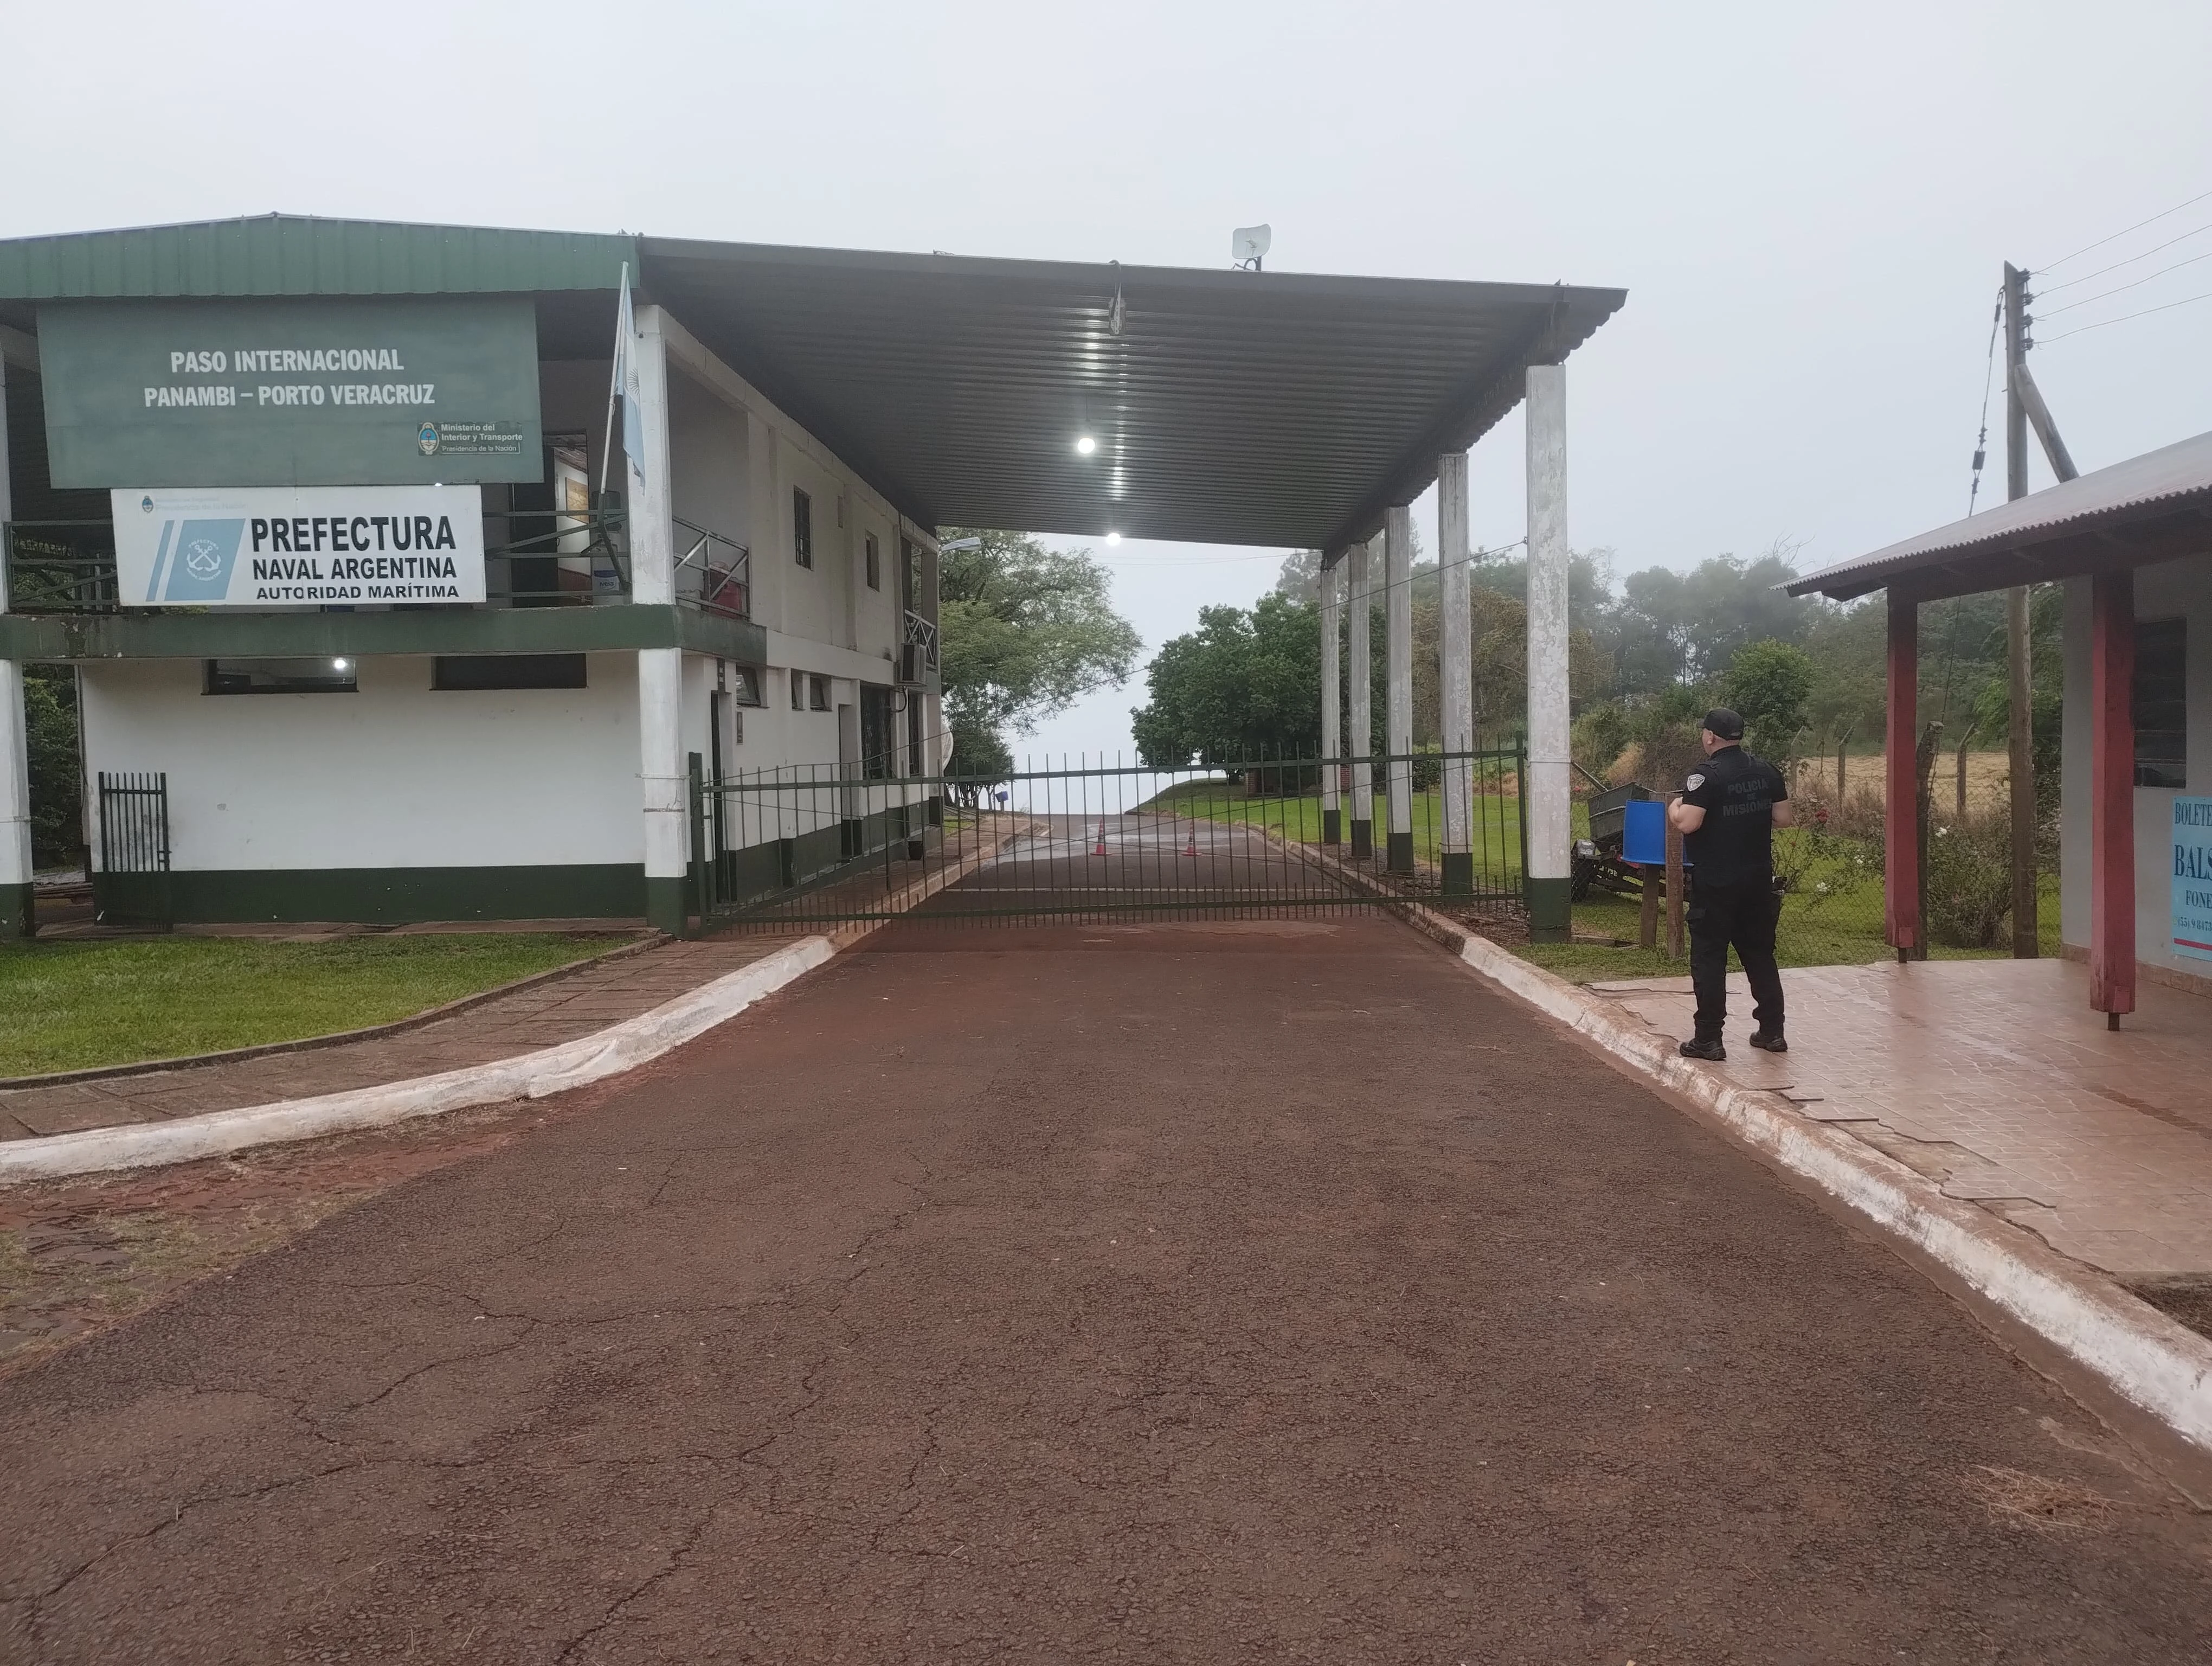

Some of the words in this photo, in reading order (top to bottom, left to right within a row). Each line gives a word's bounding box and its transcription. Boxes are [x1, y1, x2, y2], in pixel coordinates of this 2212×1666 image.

[171, 351, 227, 373] PASO
[234, 349, 405, 372] INTERNACIONAL
[144, 386, 236, 407] PANAMBI
[258, 385, 325, 406] PORTO
[330, 384, 435, 405] VERACRUZ
[480, 433, 523, 442] Transporte
[251, 516, 456, 552] PREFECTURA
[253, 558, 324, 580] NAVAL
[331, 557, 457, 580] ARGENTINA
[256, 586, 362, 600] AUTORIDAD
[368, 582, 460, 599] MARÍTIMA
